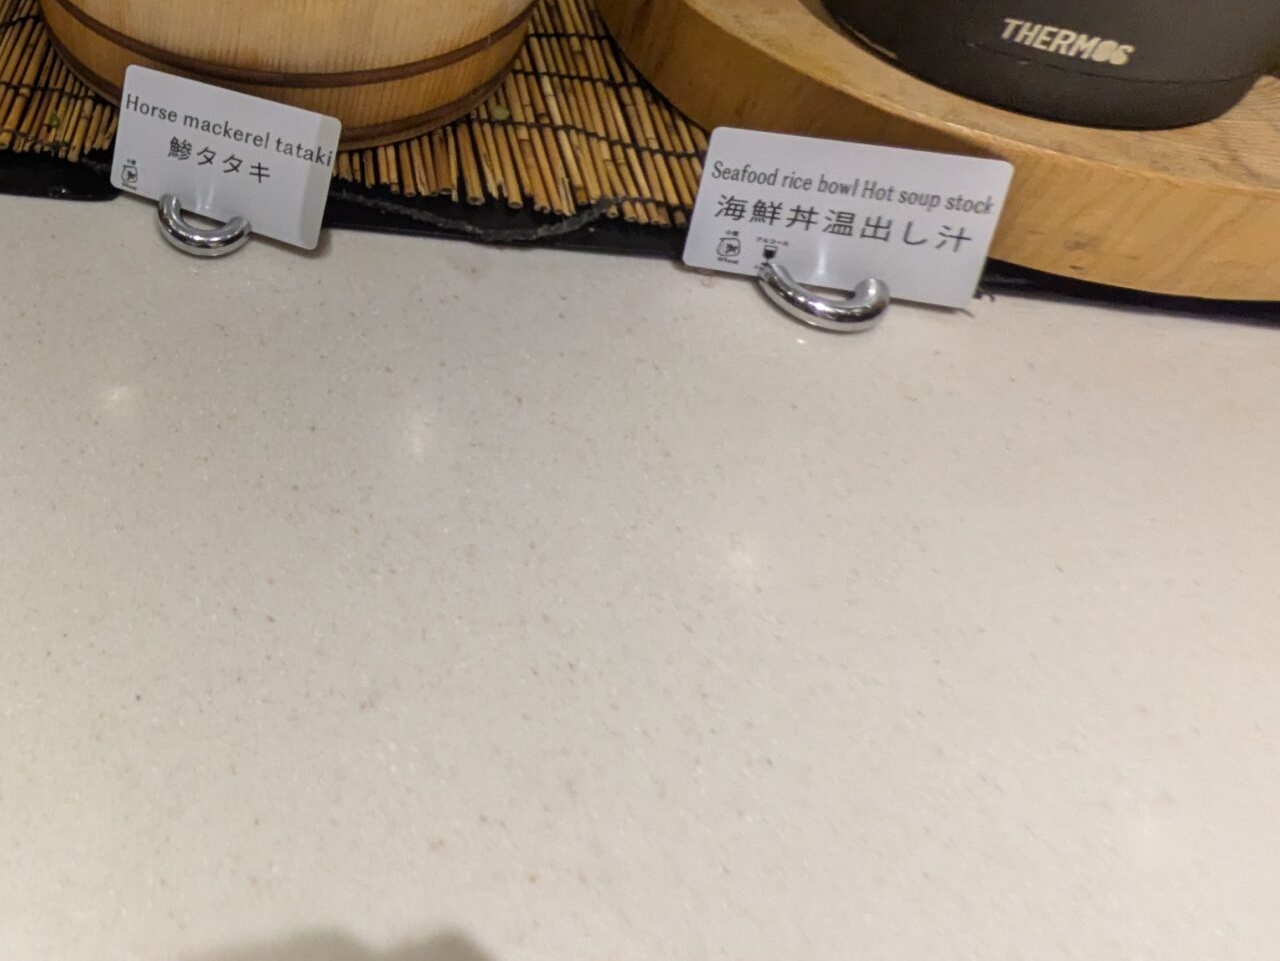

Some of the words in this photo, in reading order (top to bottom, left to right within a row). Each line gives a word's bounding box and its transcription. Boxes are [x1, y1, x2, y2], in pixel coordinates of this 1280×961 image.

[1000, 17, 1136, 66] THERMOS
[125, 93, 178, 123] Horse
[183, 112, 271, 149] mackerel
[275, 137, 333, 167] tataki
[711, 160, 779, 187] Seafood
[781, 172, 812, 191] rice
[817, 174, 859, 197] bowl
[861, 180, 895, 202] Hot
[897, 189, 941, 212] soup
[944, 195, 995, 216] stock
[714, 193, 973, 253] 海鮮丼温出し汁
